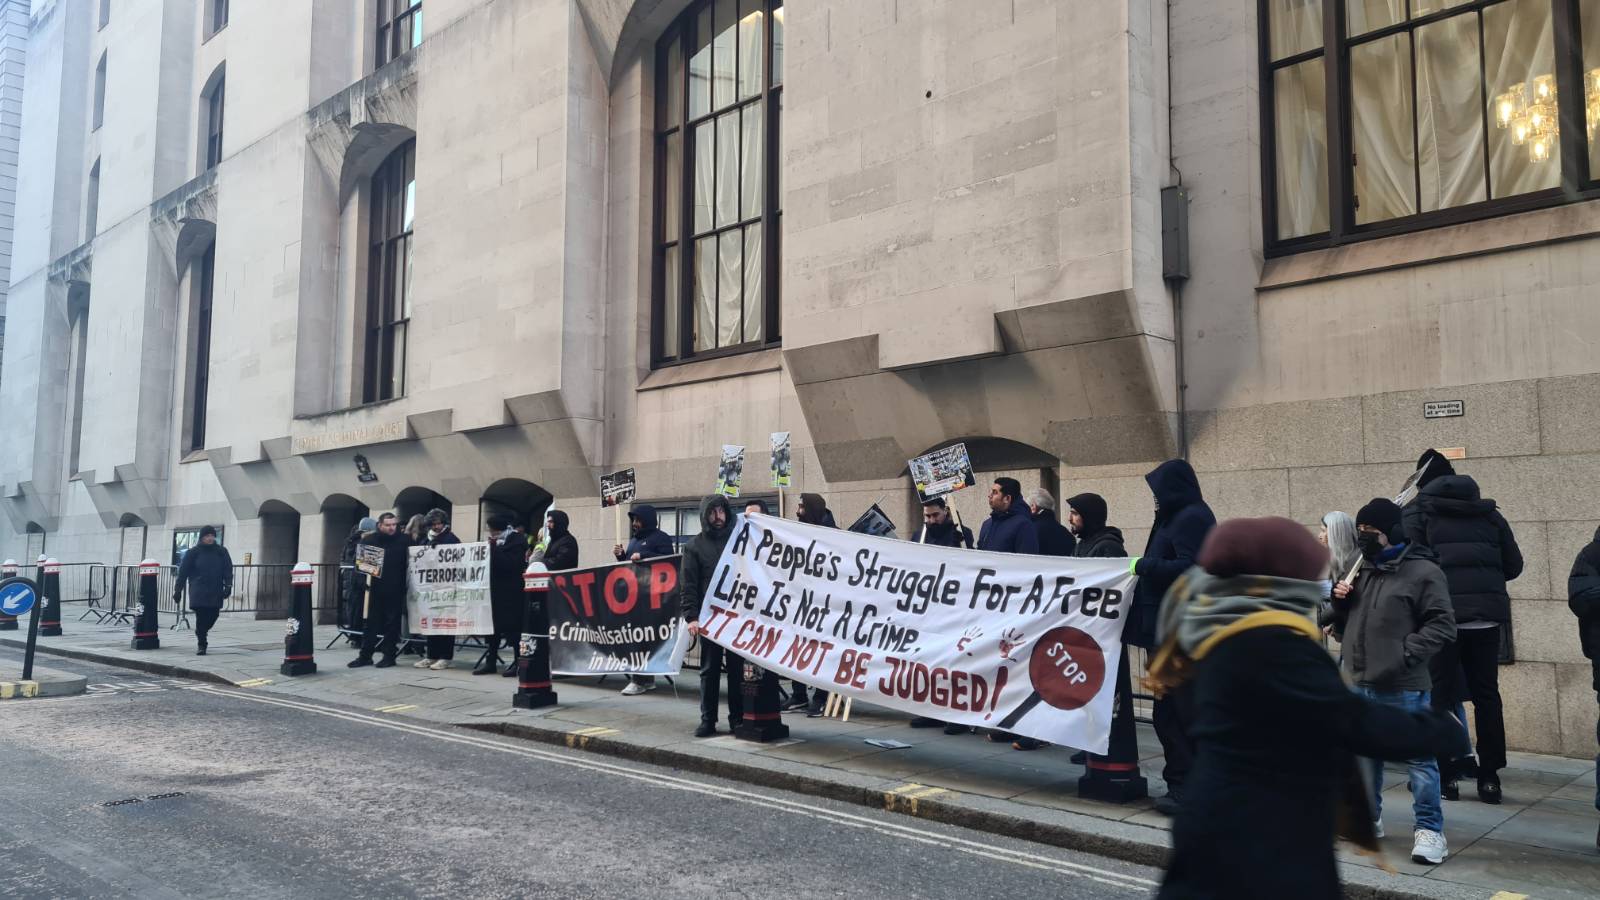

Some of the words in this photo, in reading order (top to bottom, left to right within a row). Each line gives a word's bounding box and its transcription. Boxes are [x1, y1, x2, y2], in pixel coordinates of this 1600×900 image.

[438, 547, 466, 563] SCRAP
[470, 545, 487, 561] THE
[732, 522, 750, 556] A
[754, 528, 841, 581] People's
[848, 549, 960, 615] Struggle
[969, 568, 1021, 614] For
[1019, 574, 1044, 615] A
[1042, 576, 1123, 619] Free
[470, 566, 486, 582] ACT
[714, 564, 758, 610] Life
[760, 580, 791, 621] Is
[793, 588, 830, 633] Not
[833, 600, 853, 640] A
[659, 617, 676, 641] of
[588, 650, 604, 671] in
[605, 651, 628, 672] the
[630, 651, 650, 671] UK
[699, 604, 739, 640] IT
[731, 619, 783, 659] CAN
[779, 634, 835, 676] NOT
[833, 648, 873, 689] BE
[878, 656, 1009, 721] JUDGED!
[1047, 642, 1088, 686] STOP
